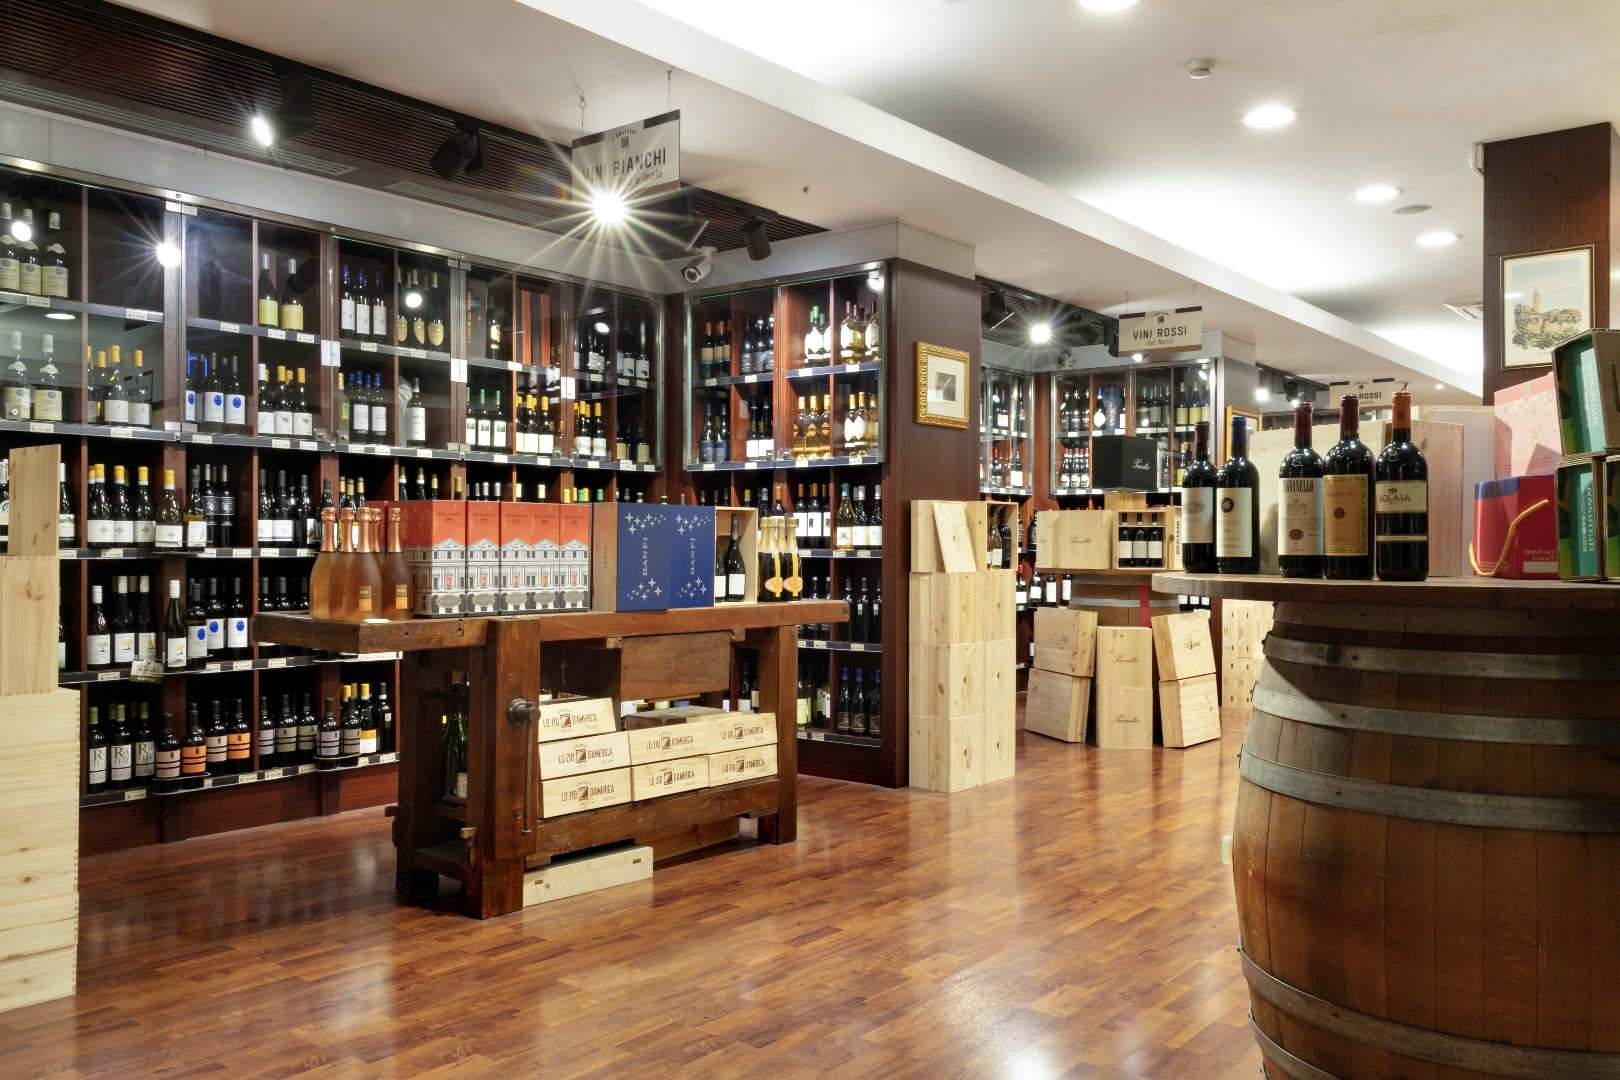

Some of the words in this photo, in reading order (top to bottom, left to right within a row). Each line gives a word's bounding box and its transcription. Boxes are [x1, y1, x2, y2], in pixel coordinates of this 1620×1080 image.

[613, 148, 666, 176] BIANCHI
[1133, 329, 1153, 340] VINI
[1157, 325, 1187, 338] ROSSI
[1158, 338, 1173, 346] Nord
[1359, 392, 1382, 400] ROSSI
[1586, 487, 1595, 552] DONNAFUGATA
